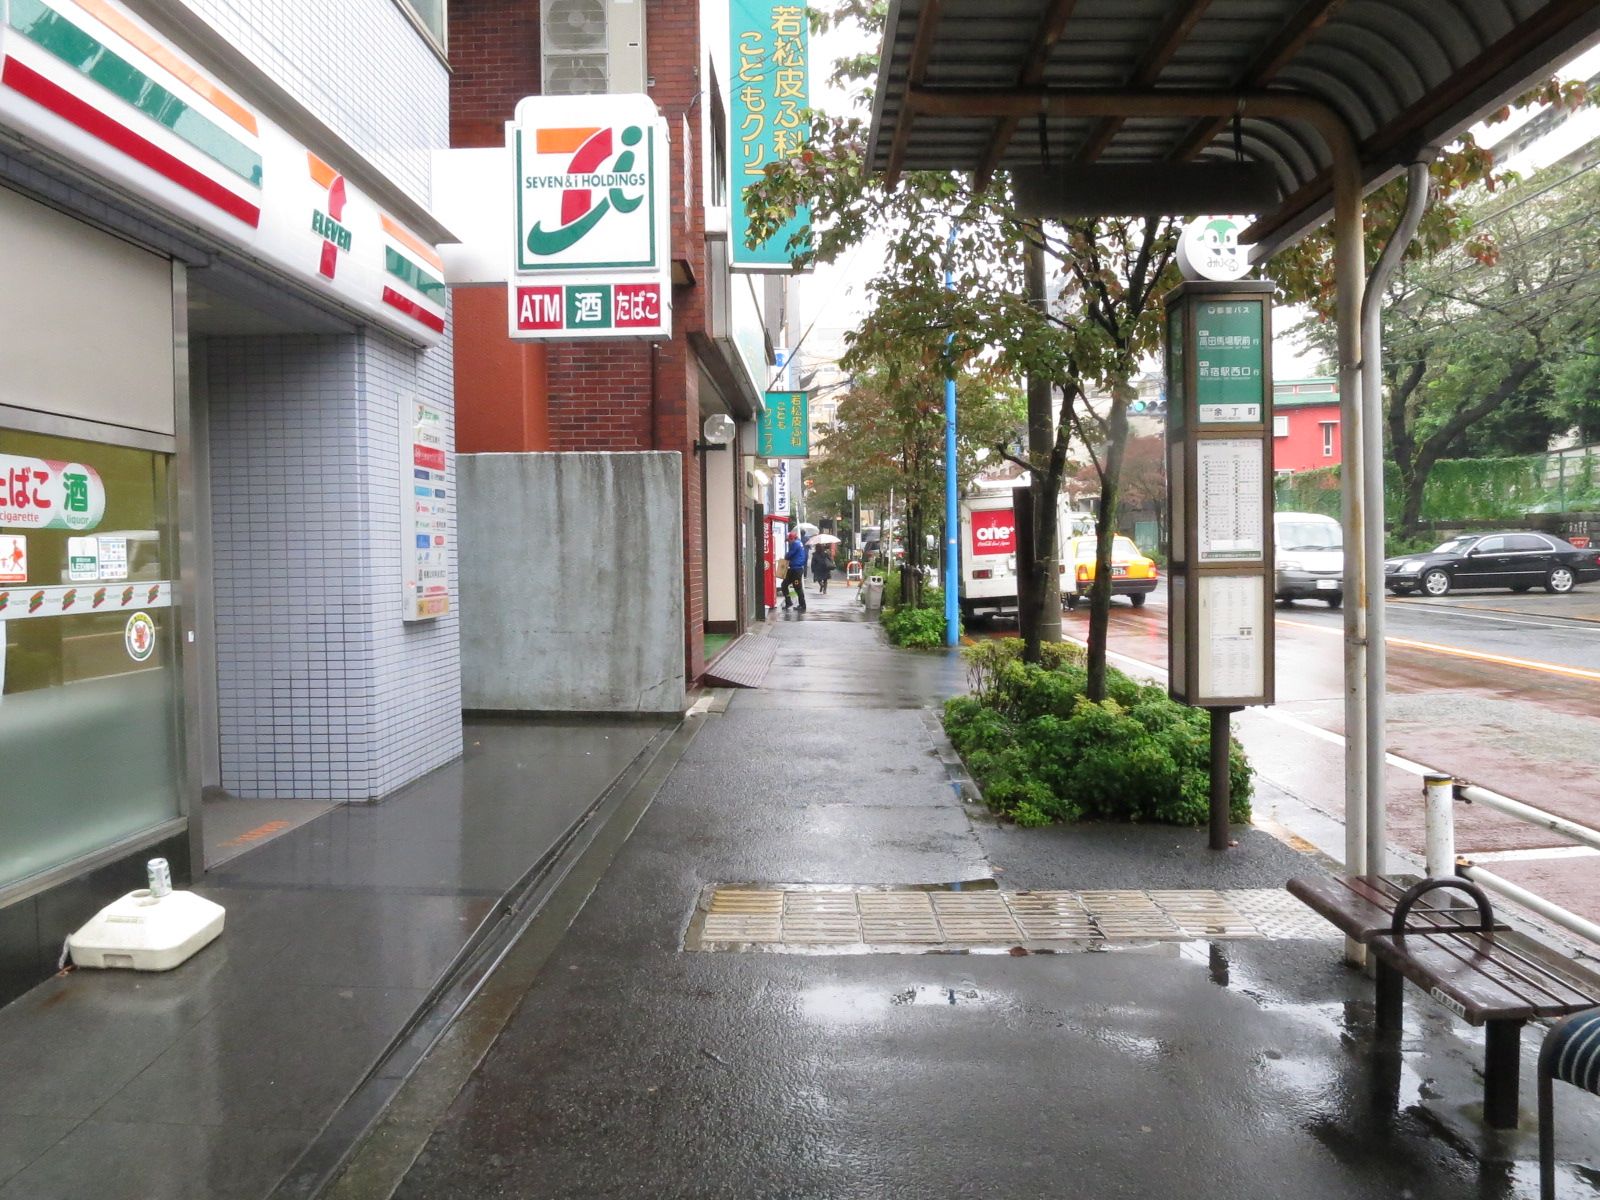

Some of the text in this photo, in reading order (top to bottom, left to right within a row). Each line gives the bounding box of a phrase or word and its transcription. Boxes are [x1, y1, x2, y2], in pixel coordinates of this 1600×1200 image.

[582, 173, 646, 188] HOLDINGS
[520, 293, 560, 324] ATM
[575, 292, 603, 324] 酒
[616, 291, 659, 322] たばこ
[1199, 366, 1251, 377] 新宿駅西口
[63, 472, 88, 512] 酒
